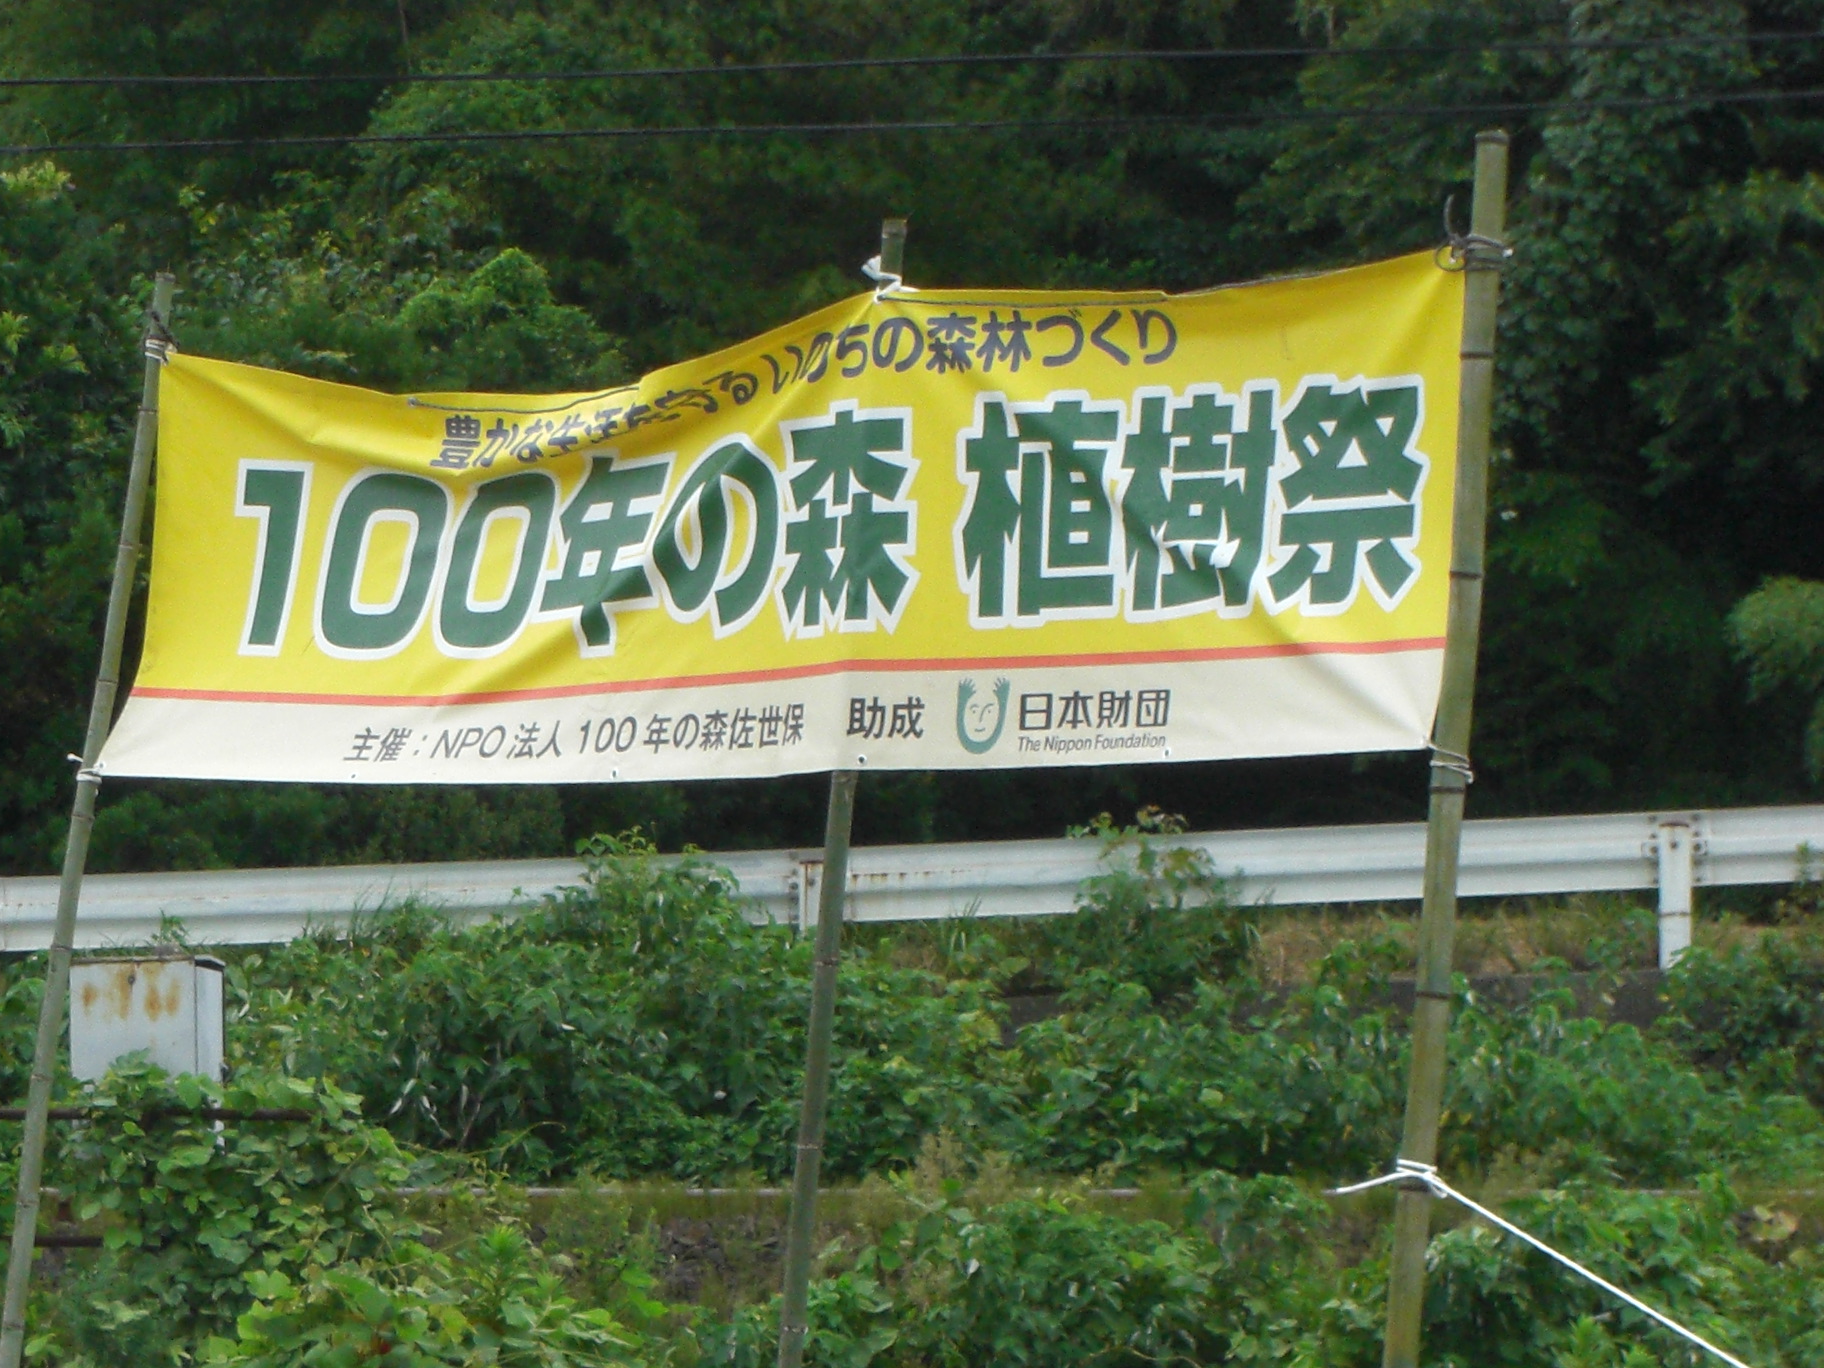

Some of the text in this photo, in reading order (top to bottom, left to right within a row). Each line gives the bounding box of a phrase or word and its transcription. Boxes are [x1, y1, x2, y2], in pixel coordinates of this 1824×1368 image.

[238, 378, 1426, 656] 100年の森 植樹祭
[846, 696, 925, 739] 助成
[1018, 689, 1171, 731] 日本財団
[1017, 733, 1166, 754] The Nippon Foundation
